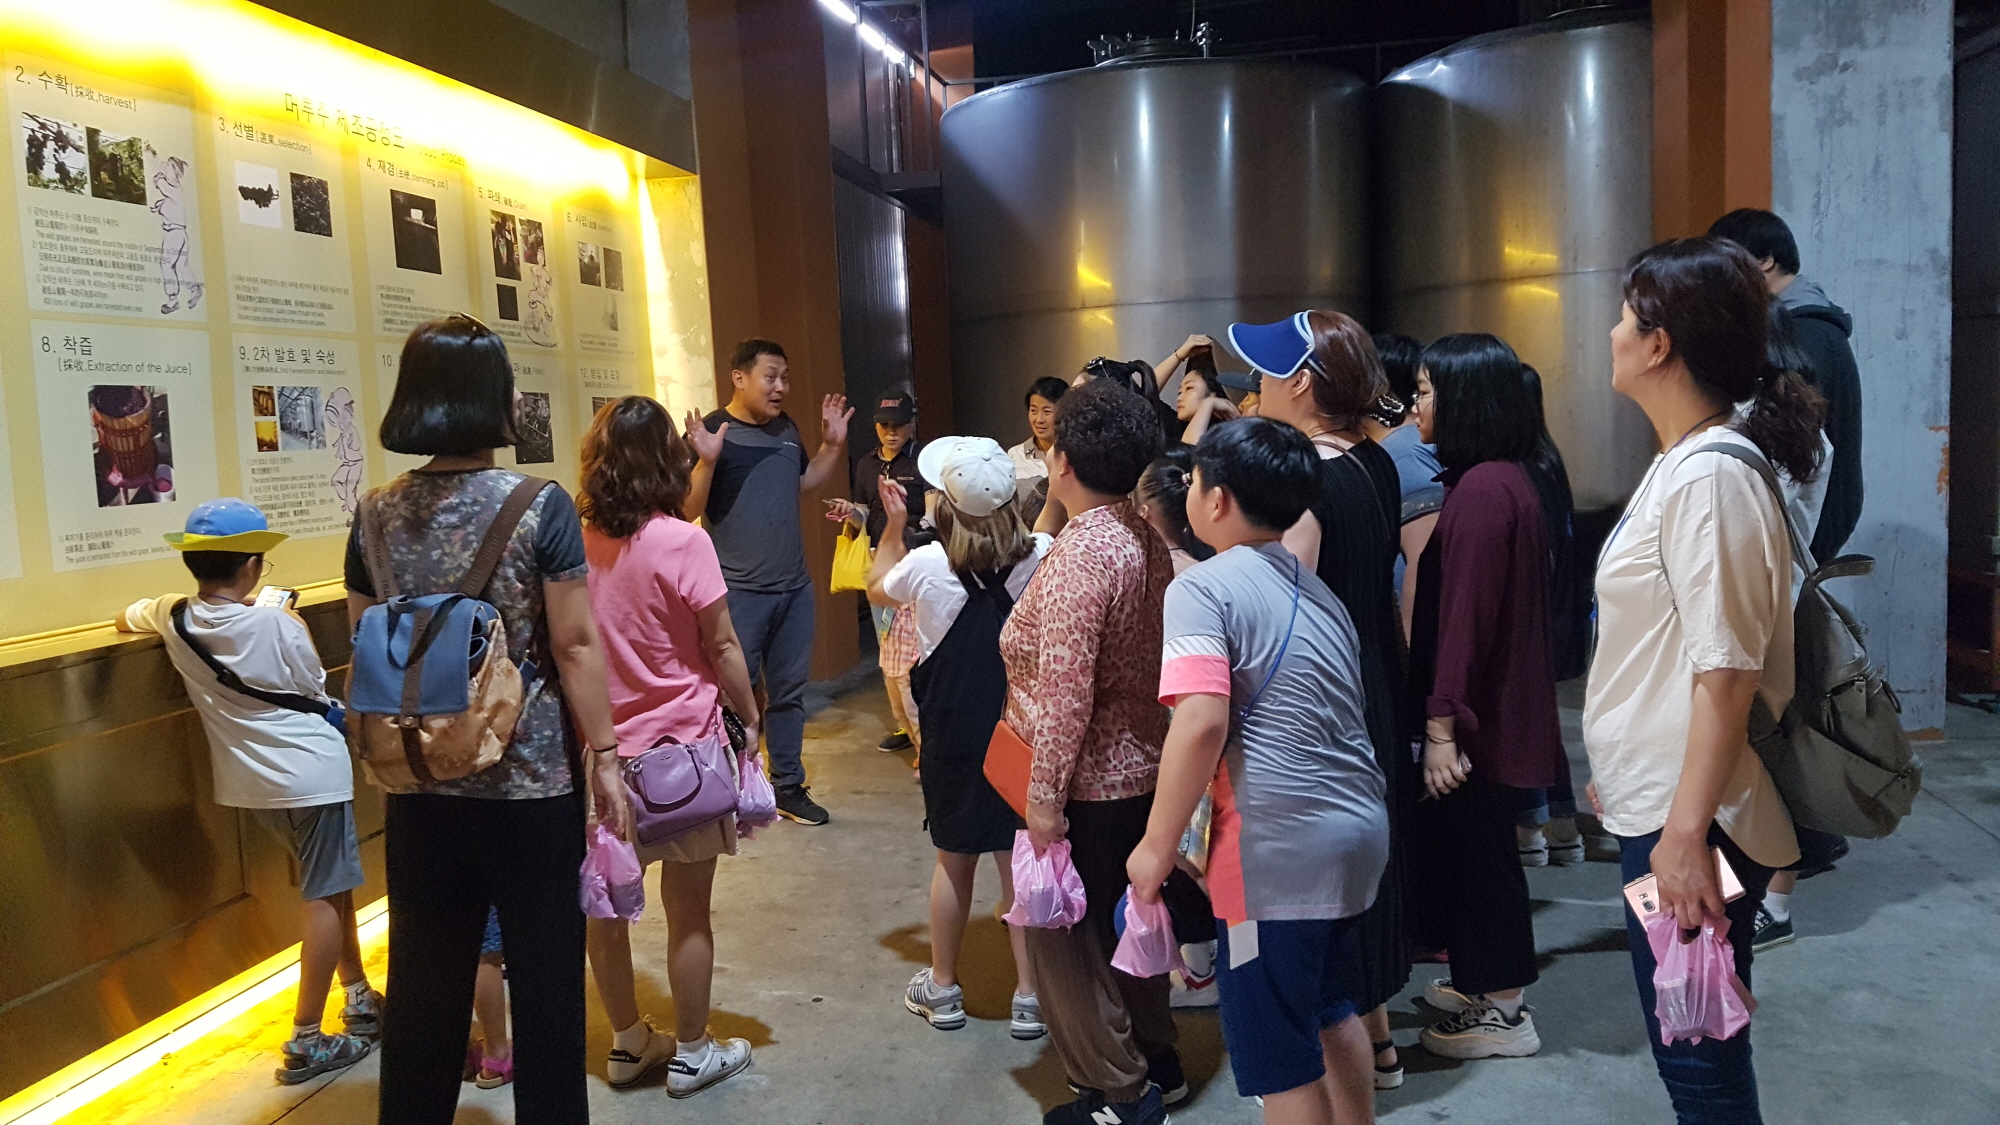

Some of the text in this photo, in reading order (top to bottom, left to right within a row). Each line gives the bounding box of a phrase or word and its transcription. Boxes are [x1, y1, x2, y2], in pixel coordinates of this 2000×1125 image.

[16, 66, 30, 84] 2.
[219, 117, 229, 133] 3.
[367, 157, 375, 170] 4.
[42, 335, 92, 356] 8. 착즙
[240, 346, 334, 364] 9. 2차 발효 및 숙성
[382, 355, 395, 367] 10.
[136, 362, 145, 372] of
[147, 362, 162, 373] the
[165, 363, 192, 375] Juice]
